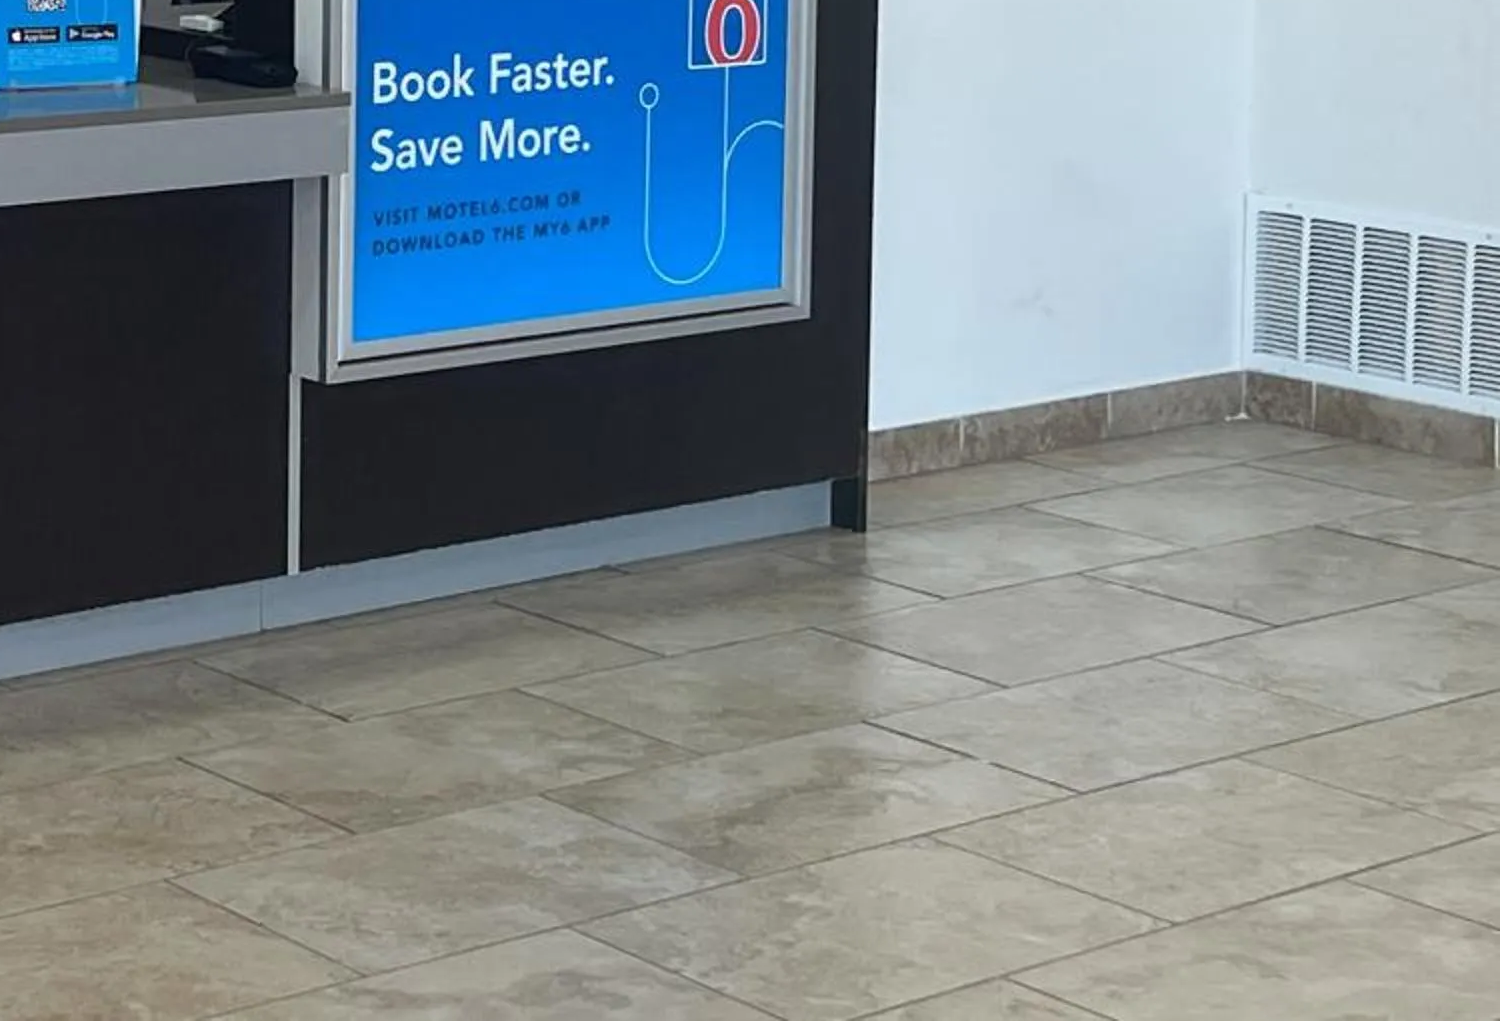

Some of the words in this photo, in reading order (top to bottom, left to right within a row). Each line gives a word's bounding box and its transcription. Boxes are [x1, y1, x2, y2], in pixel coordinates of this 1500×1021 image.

[371, 53, 475, 105] Book
[488, 52, 615, 95] Faster.
[369, 129, 464, 173] Save
[478, 118, 591, 162] More.
[372, 206, 419, 228] VISIT
[426, 195, 550, 222] MOTEL6.COM
[556, 191, 581, 210] OR
[371, 228, 485, 258] DOWNLOAD
[492, 223, 526, 243] THE
[532, 219, 571, 240] MY6
[577, 215, 611, 235] APP
